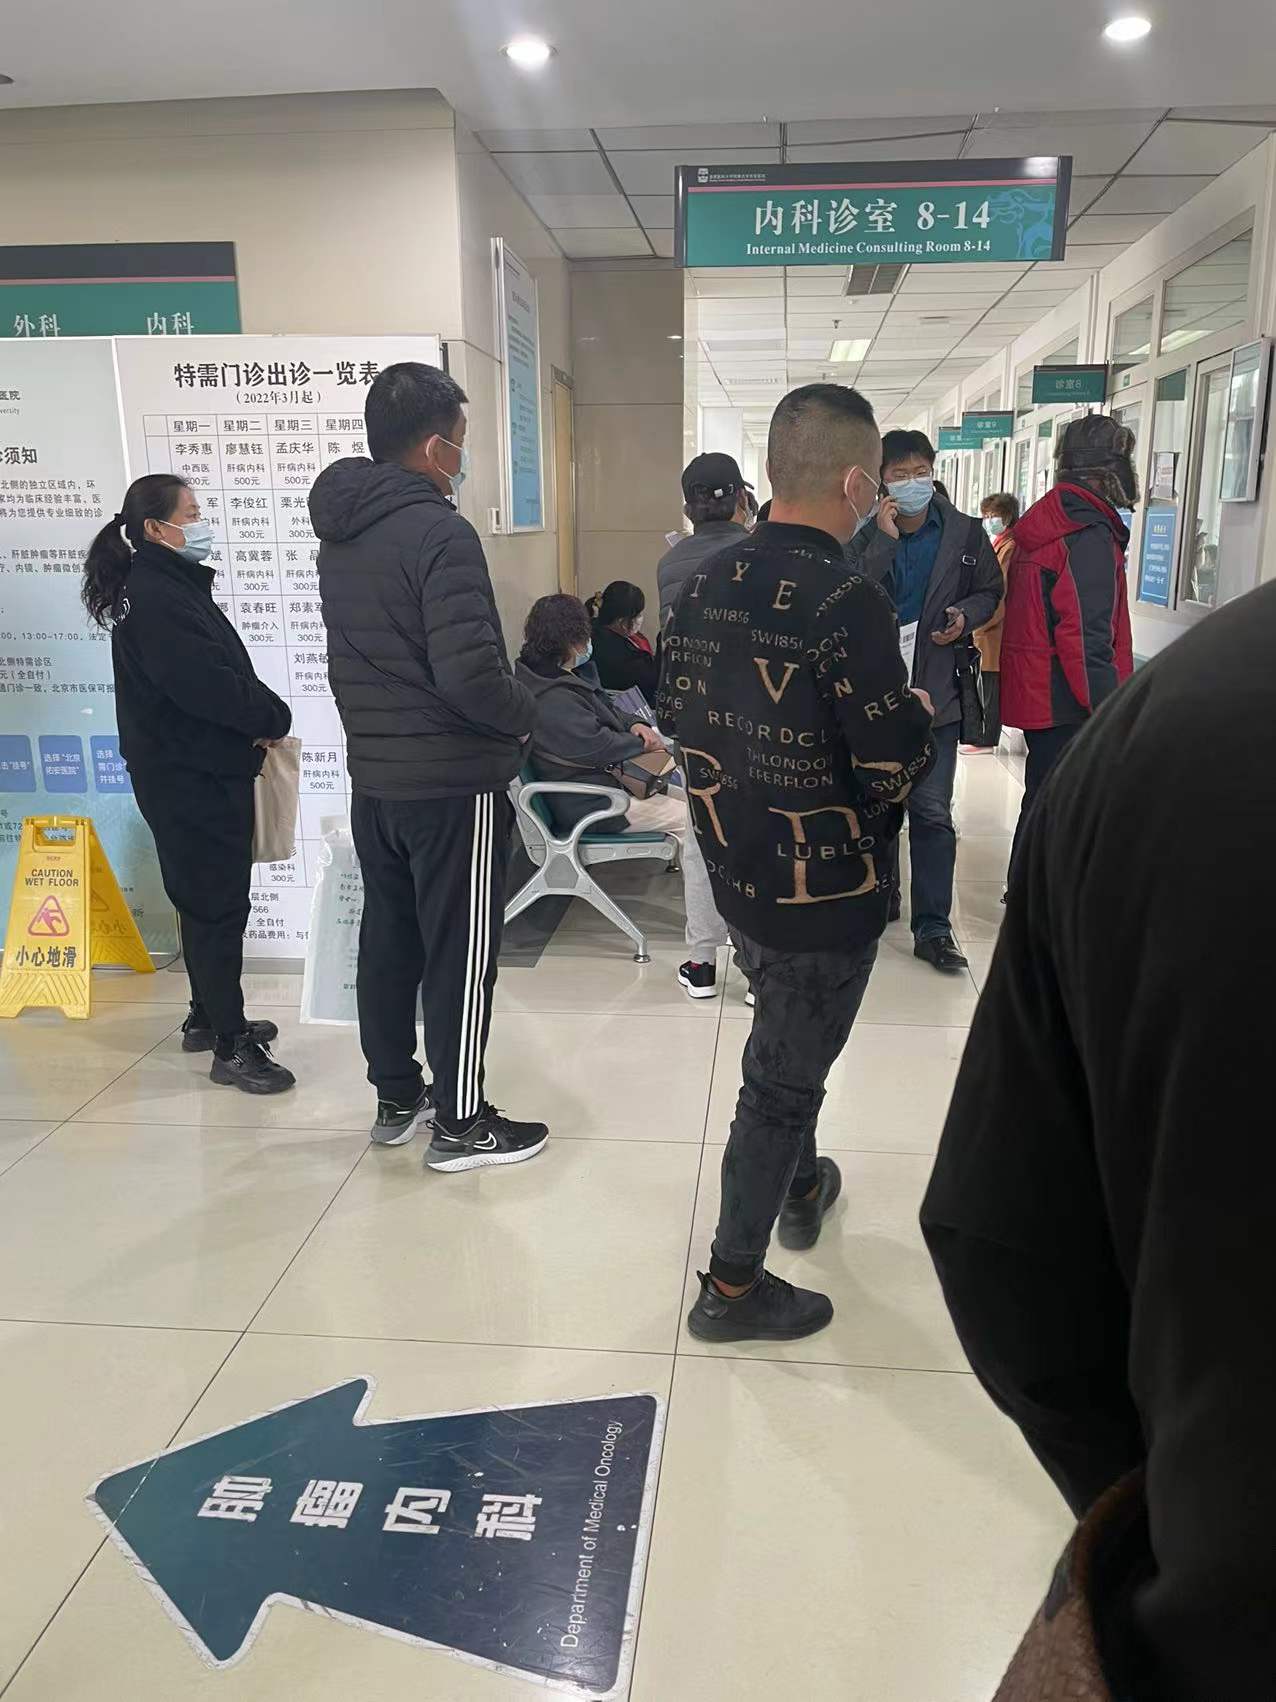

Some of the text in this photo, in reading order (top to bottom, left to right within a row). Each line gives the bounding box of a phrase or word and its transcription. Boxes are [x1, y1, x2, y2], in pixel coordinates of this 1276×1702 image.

[755, 198, 990, 236] 内科诊室 8-14
[746, 239, 991, 255] Internal Medicine Consulting Room 8-14
[13, 313, 61, 337] 外科
[146, 311, 194, 336] 内科
[174, 361, 380, 388] 特需门诊出诊一览表
[173, 419, 211, 432] 星期一
[223, 419, 262, 431] 星期二
[274, 418, 313, 431] 星期三
[325, 418, 364, 431] 星期四
[175, 442, 213, 456] 李秀惠
[276, 441, 315, 454] 孟庆华
[0, 447, 38, 465] 须知
[182, 463, 210, 473] 中西医
[226, 463, 265, 473] 肝病内科
[277, 462, 316, 472] 肝病内科
[234, 477, 261, 486] 500元
[284, 476, 311, 485] 500元
[232, 517, 269, 526] 肝病内科
[239, 530, 265, 539] 300元
[289, 530, 315, 539] 300元
[237, 570, 274, 579] 肝病内科
[244, 582, 270, 591] 300元
[293, 582, 319, 591] 300元
[240, 602, 278, 613] 袁春旺
[241, 621, 279, 631] 肿瘤介入
[249, 633, 275, 642] 300元
[297, 633, 323, 642] 300元
[302, 684, 328, 692] 300元
[302, 751, 338, 763] 陈新月
[303, 769, 340, 779] 肝病内科
[309, 781, 335, 790] 500元
[31, 869, 73, 878] CAUTION
[271, 874, 296, 883] 300元
[25, 878, 79, 887] WET FLOOR
[15, 944, 77, 969] 小心地滑
[197, 1473, 543, 1542] 肿瘤内科
[560, 1419, 624, 1649] Department of Medical Oncology
